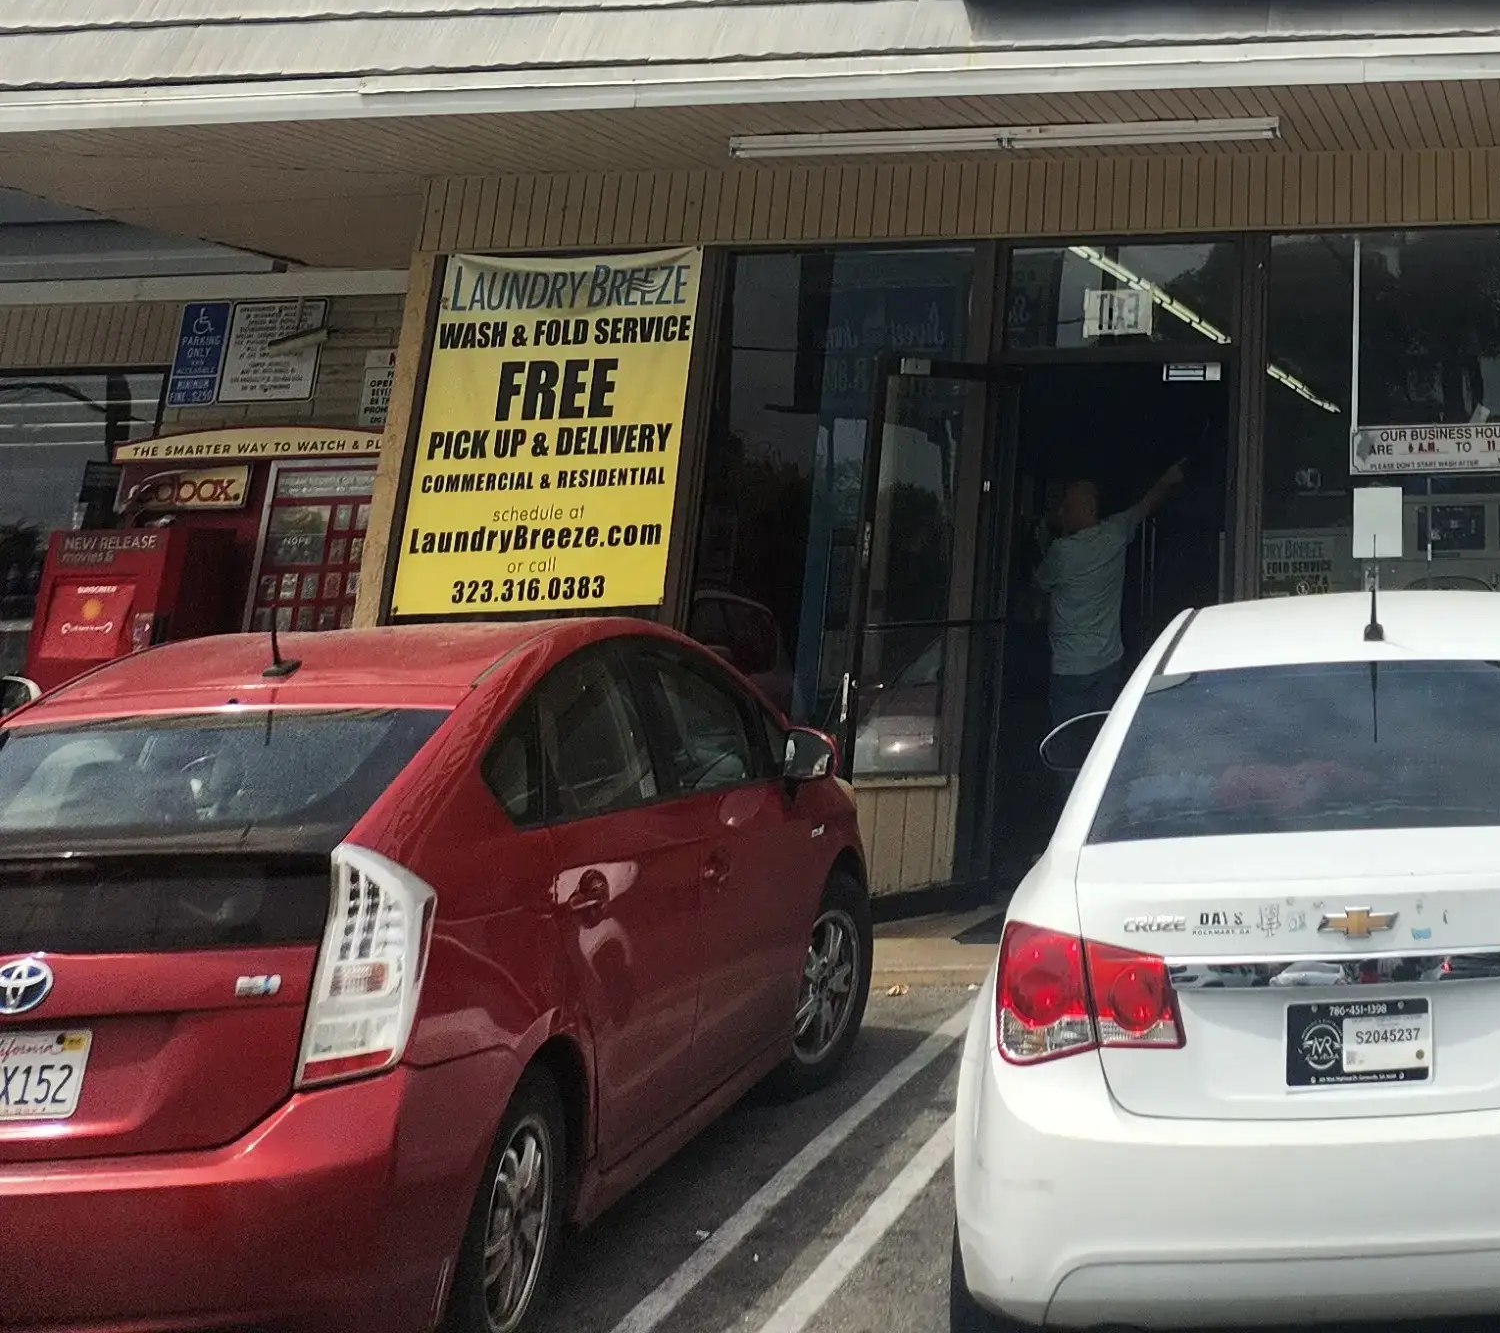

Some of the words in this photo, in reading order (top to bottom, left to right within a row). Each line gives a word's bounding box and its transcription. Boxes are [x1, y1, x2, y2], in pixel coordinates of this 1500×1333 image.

[451, 265, 586, 311] LAUNDRY
[587, 264, 690, 308] BREEZE
[182, 335, 221, 345] PARKING
[439, 321, 507, 349] WASH
[511, 324, 528, 347] &
[533, 318, 589, 346] FOLD
[594, 315, 691, 343] SERVICE
[187, 347, 211, 357] ONLY
[495, 358, 619, 422] FREE
[427, 429, 490, 460] PICK
[493, 429, 526, 459] UP
[531, 432, 549, 457] &
[555, 423, 672, 456] DELIVERY
[1380, 431, 1406, 442] OUR
[1411, 428, 1472, 441] BUSINESS
[133, 446, 159, 456] THE
[165, 444, 230, 456] SMARTER
[237, 444, 267, 454] WAY
[274, 442, 291, 452] TO
[297, 440, 345, 452] WATCH
[352, 441, 359, 450] &
[1369, 445, 1393, 455] ARE
[1418, 443, 1440, 452] A.M.
[1456, 442, 1472, 453] TO
[1487, 440, 1496, 451] 11
[421, 472, 533, 493] COMMERCIAL
[540, 474, 550, 489] &
[557, 467, 666, 489] RESIDENTIAL
[493, 504, 563, 522] schedule
[569, 505, 584, 519] at
[100, 535, 157, 550] RELEASE
[409, 523, 662, 554] LaundryBreeze.com
[507, 561, 522, 574] or
[529, 557, 556, 573] call
[451, 575, 605, 604] 323.316.0383
[1123, 914, 1187, 932] CRUZE
[1356, 1028, 1420, 1044] S2045237
